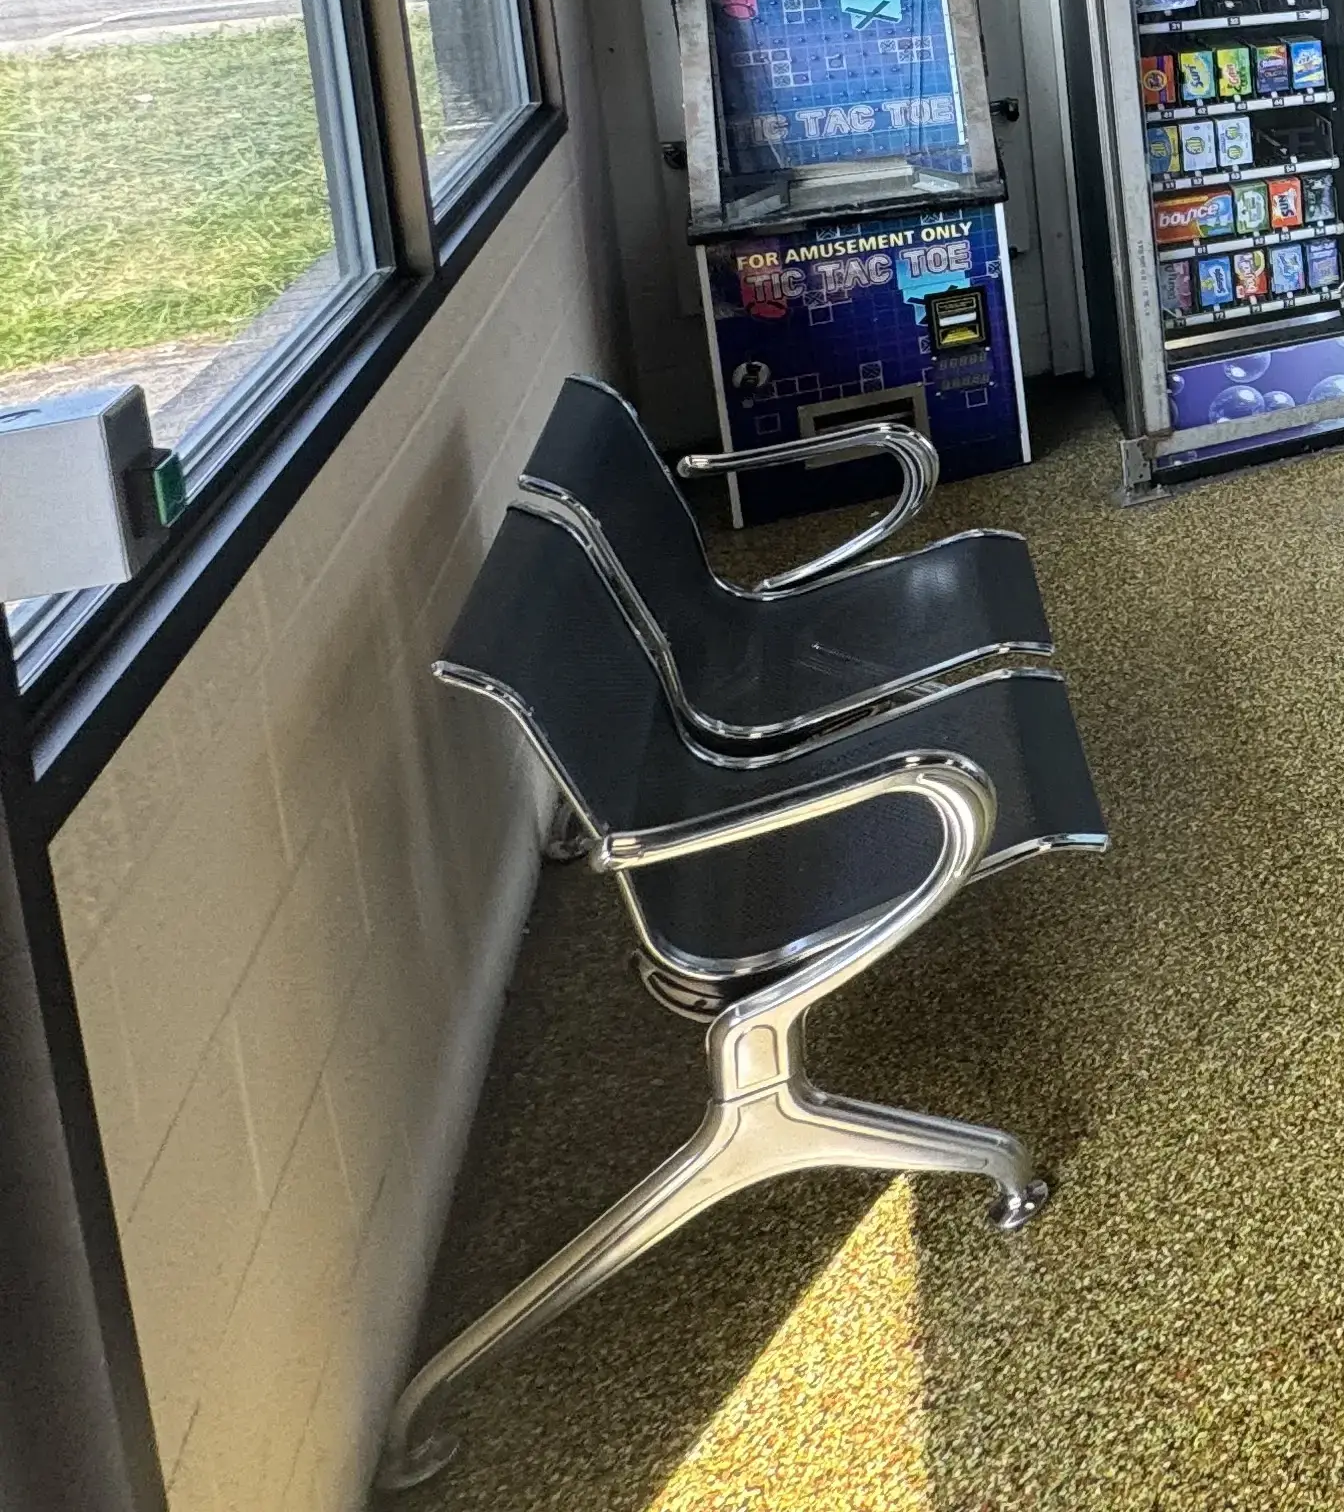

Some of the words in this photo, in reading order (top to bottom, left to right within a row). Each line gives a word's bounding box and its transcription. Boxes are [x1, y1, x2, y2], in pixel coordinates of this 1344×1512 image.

[795, 104, 876, 138] TAC
[882, 95, 955, 129] TOE
[1159, 202, 1220, 228] bounce
[1278, 194, 1295, 218] SUN
[736, 251, 779, 271] FOR
[785, 230, 914, 264] AMUSEMENT
[920, 221, 973, 242] ONLY
[746, 267, 807, 302] TIC
[815, 253, 894, 293] TAC
[901, 240, 972, 279] TOE
